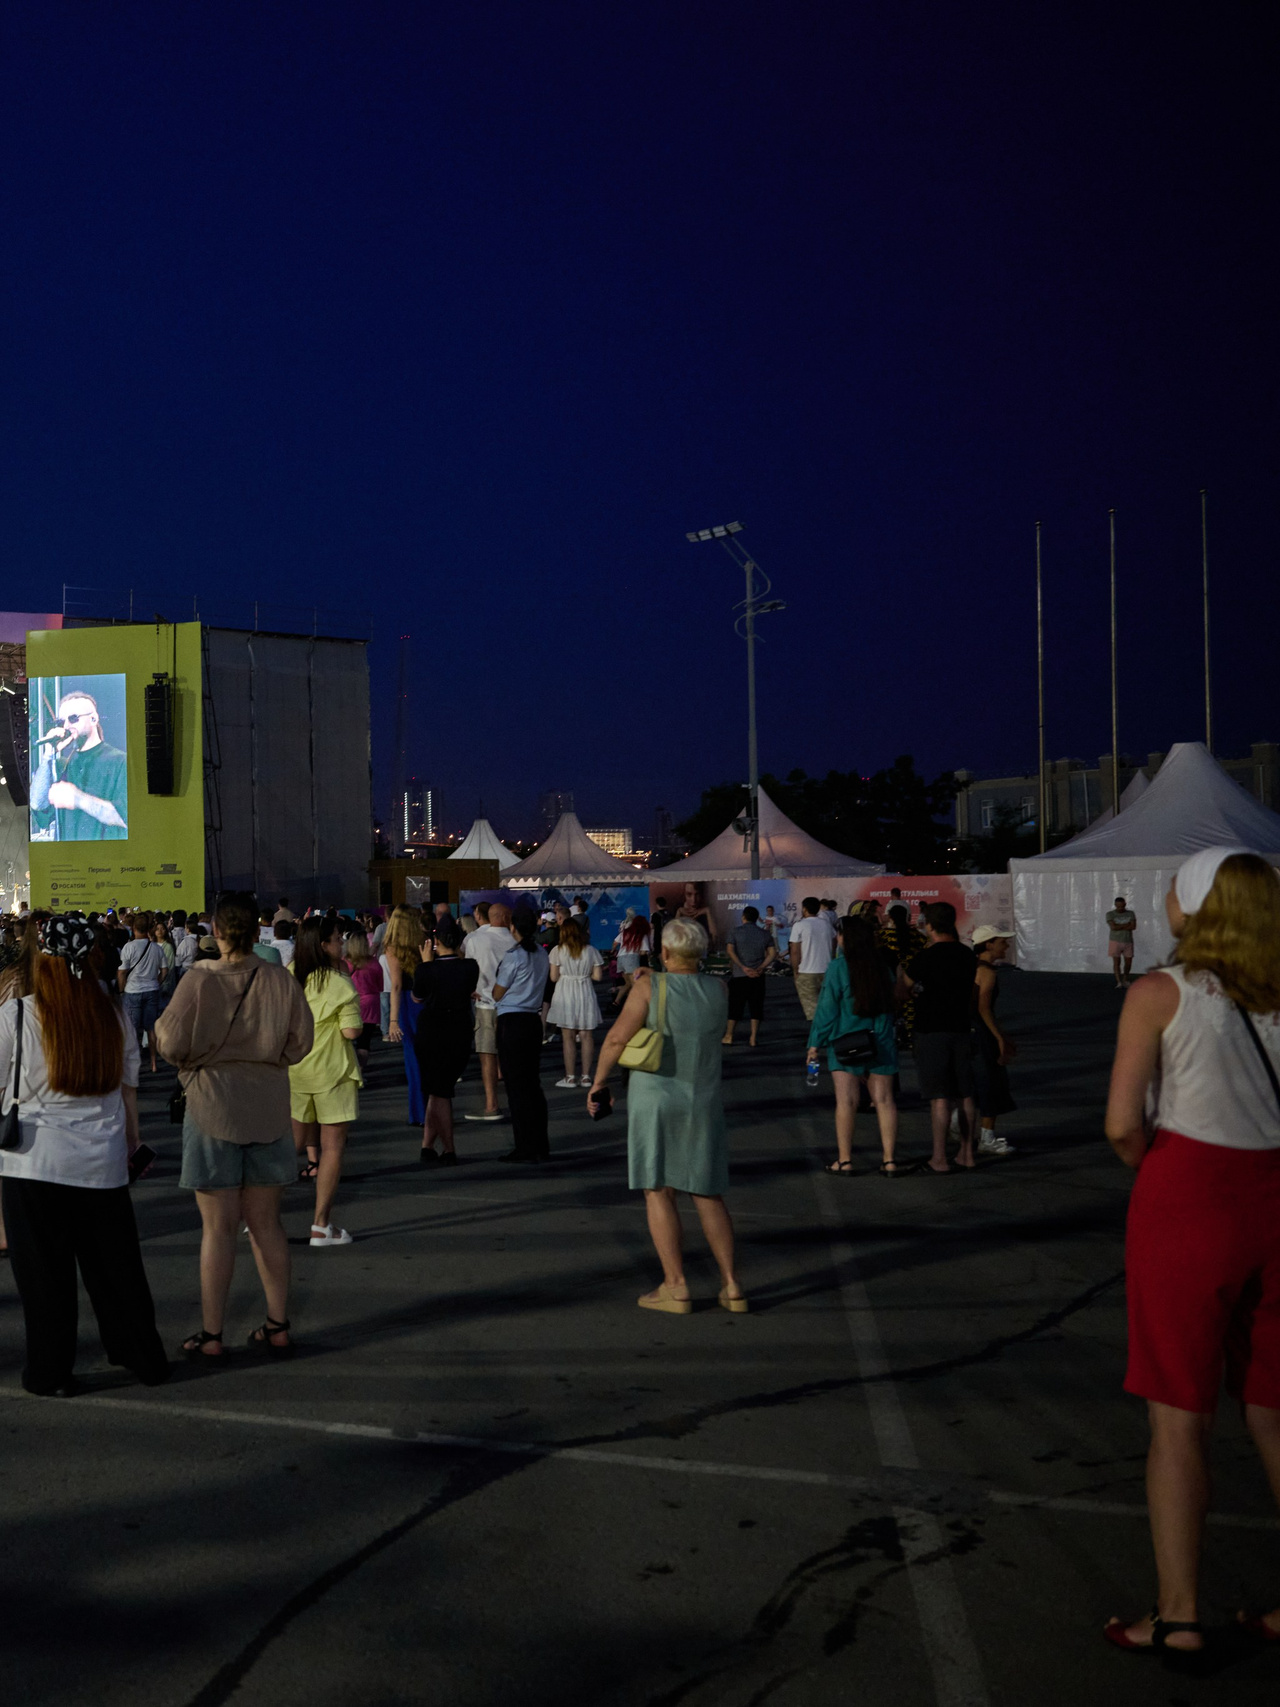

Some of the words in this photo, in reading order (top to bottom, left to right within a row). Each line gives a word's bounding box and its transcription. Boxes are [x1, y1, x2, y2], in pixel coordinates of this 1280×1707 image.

[717, 893, 760, 901] ШАХМАТНАЯ
[869, 890, 940, 898] ИНТЕЛКТУАЛЬНАЯ
[783, 902, 797, 912] 165
